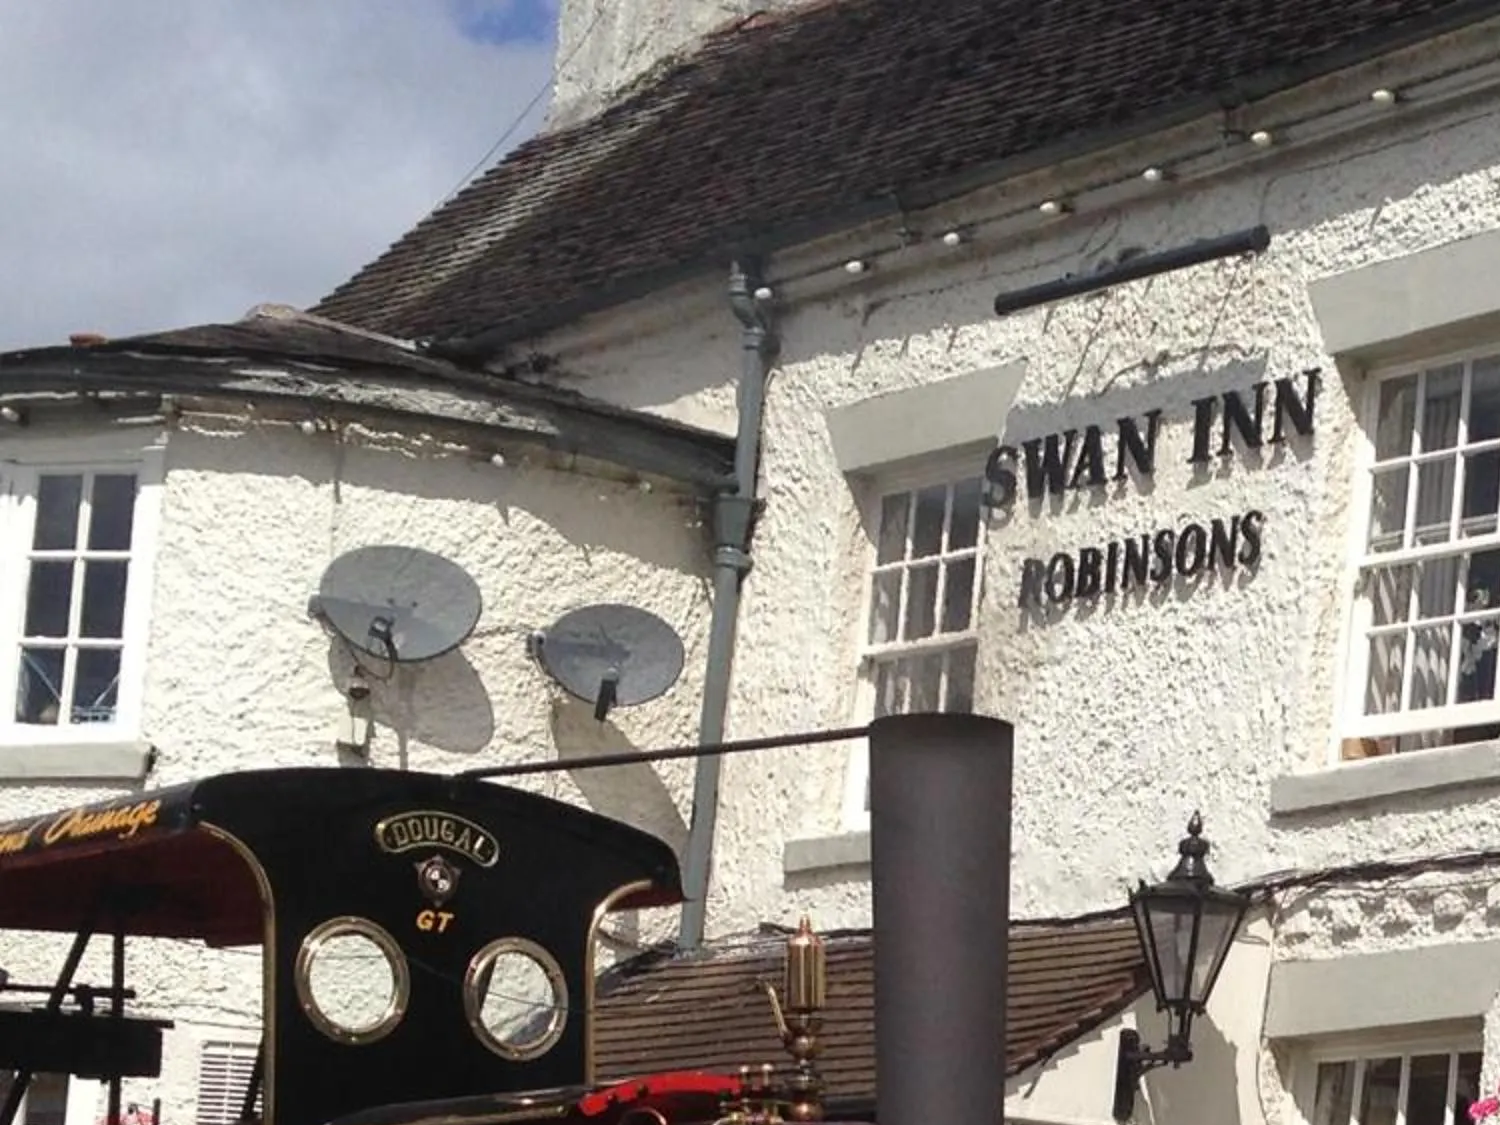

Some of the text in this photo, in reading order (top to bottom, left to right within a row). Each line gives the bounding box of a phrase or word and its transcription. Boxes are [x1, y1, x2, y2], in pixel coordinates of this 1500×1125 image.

[984, 367, 1322, 509] SWAN INN
[1018, 509, 1267, 609] ROBINSONS
[390, 816, 486, 862] DOUGAL
[416, 908, 455, 933] GT
